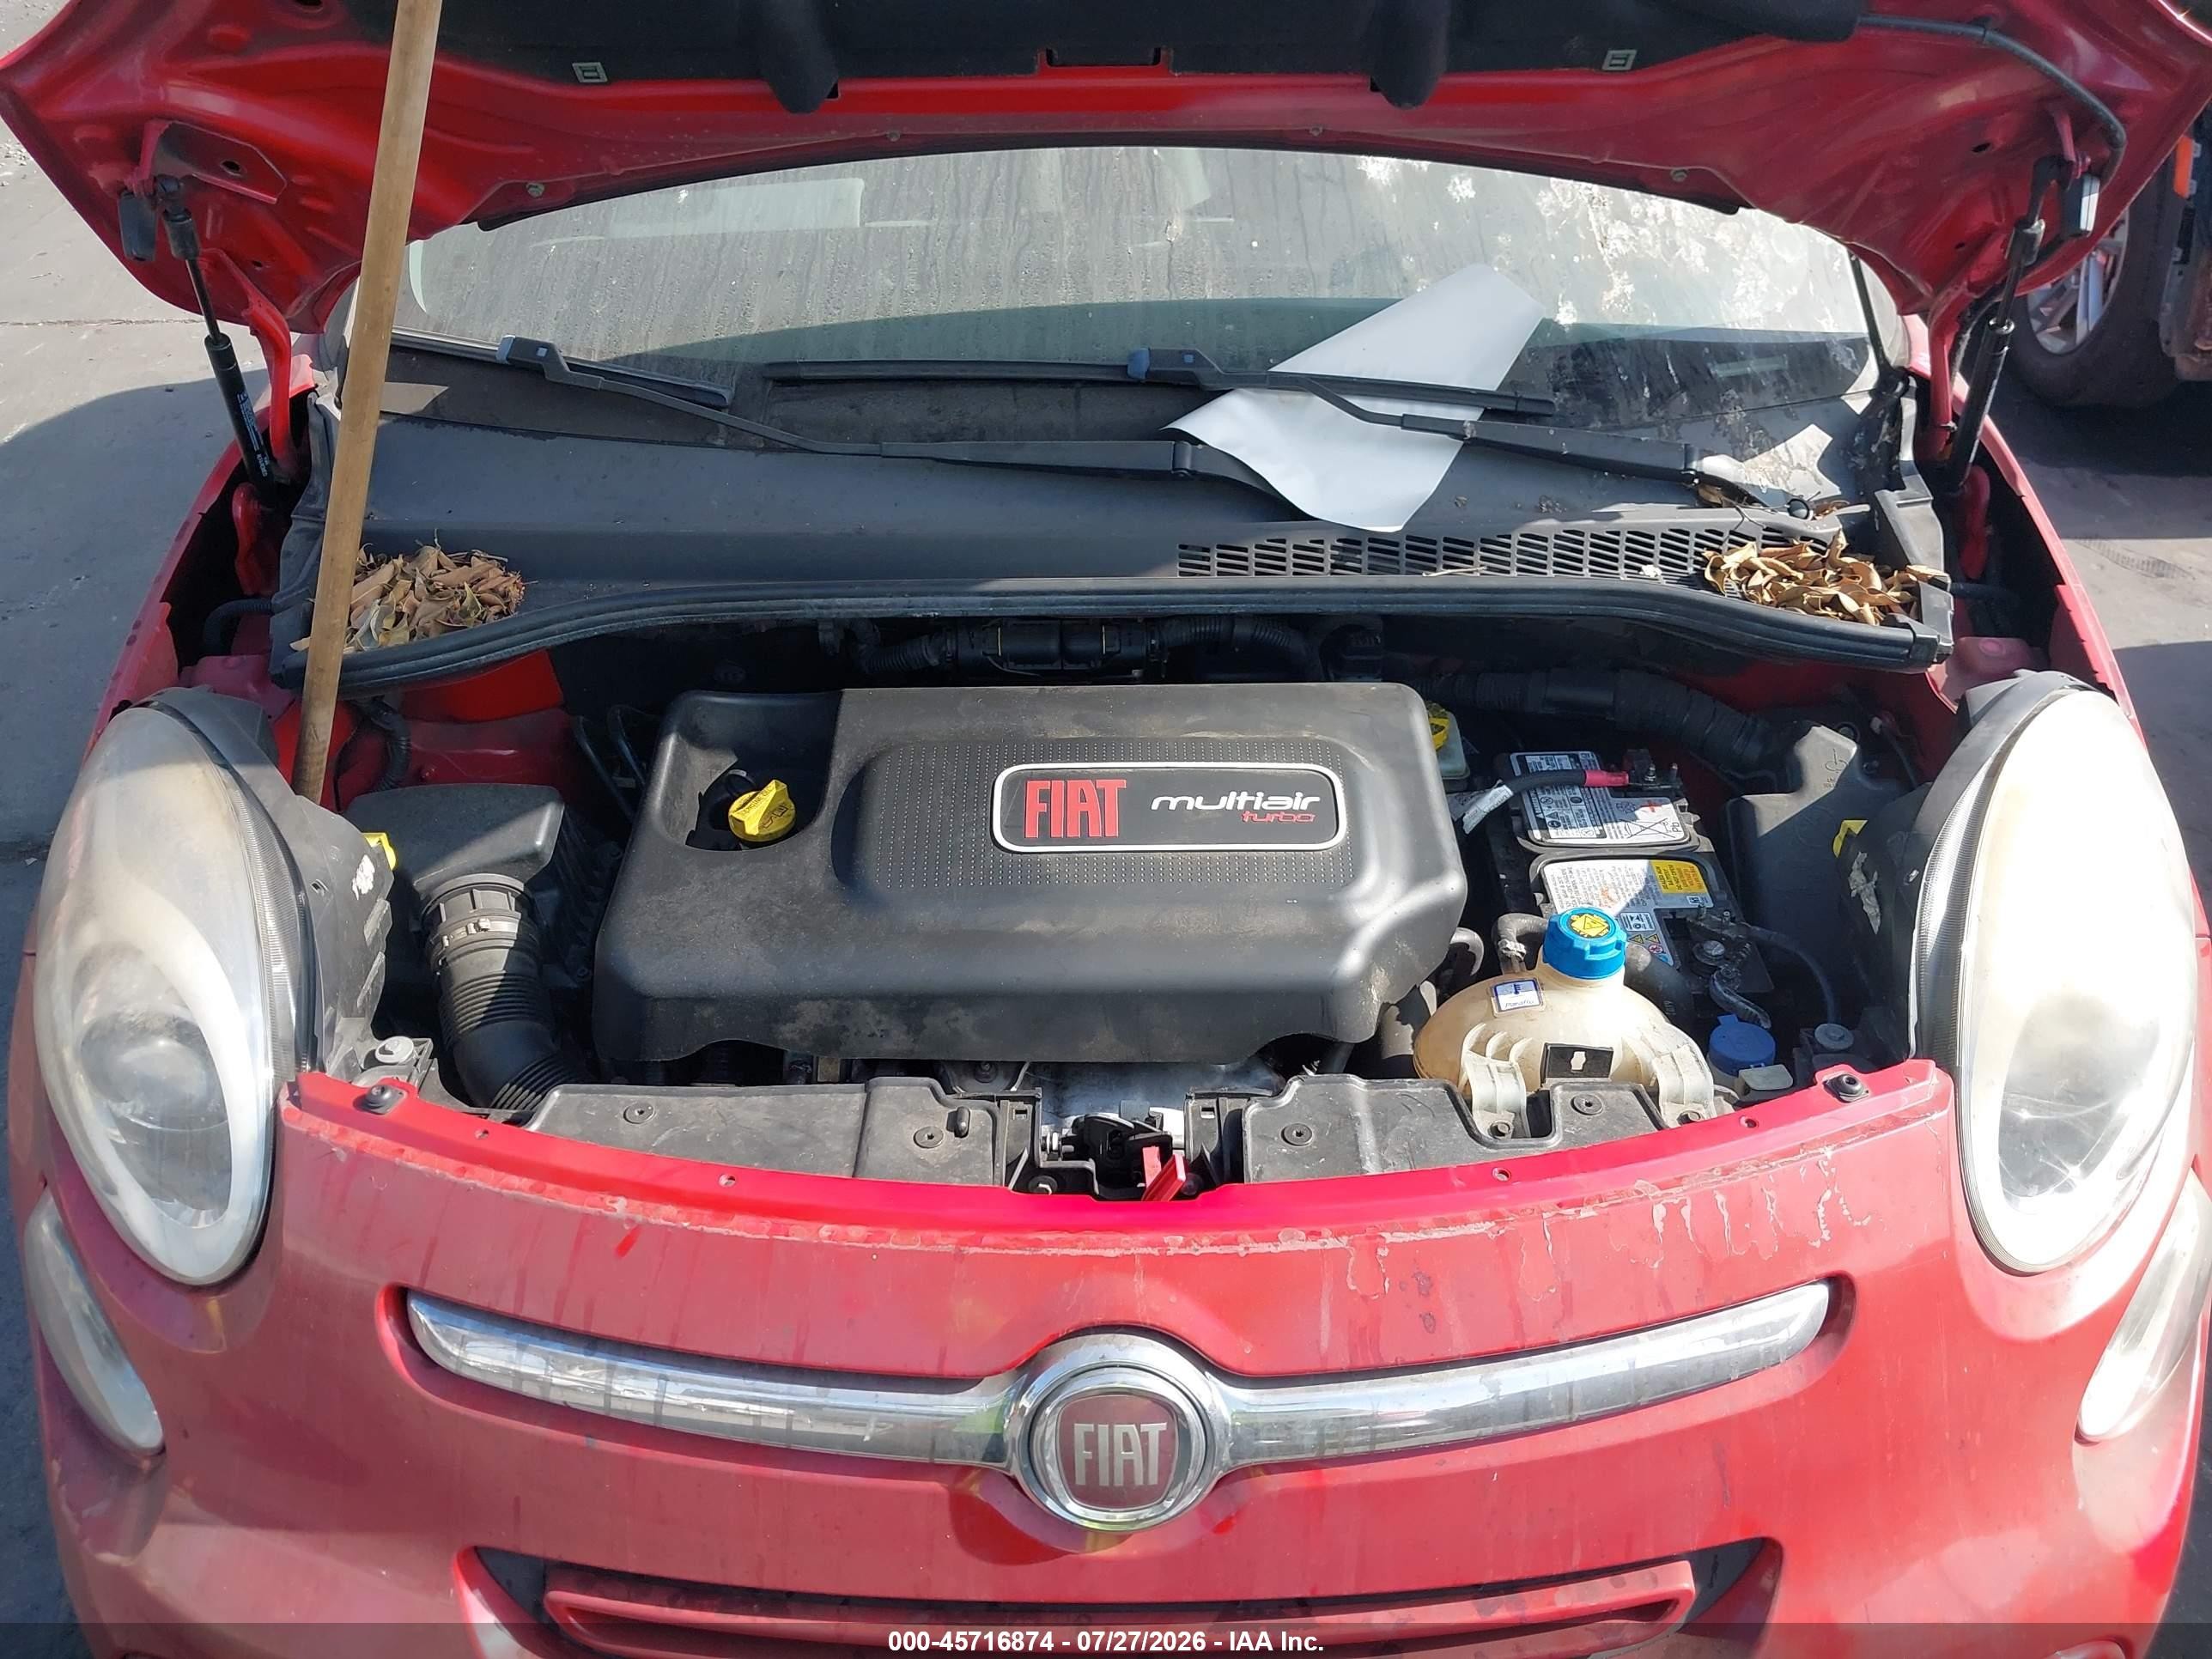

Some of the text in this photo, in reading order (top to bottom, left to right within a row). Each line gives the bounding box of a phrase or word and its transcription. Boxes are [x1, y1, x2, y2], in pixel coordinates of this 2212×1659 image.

[1024, 779, 1321, 838] FIAT multiair
[1242, 811, 1316, 823] turbo
[1670, 822, 1682, 832] Pb
[1074, 1422, 1168, 1486] FIAT
